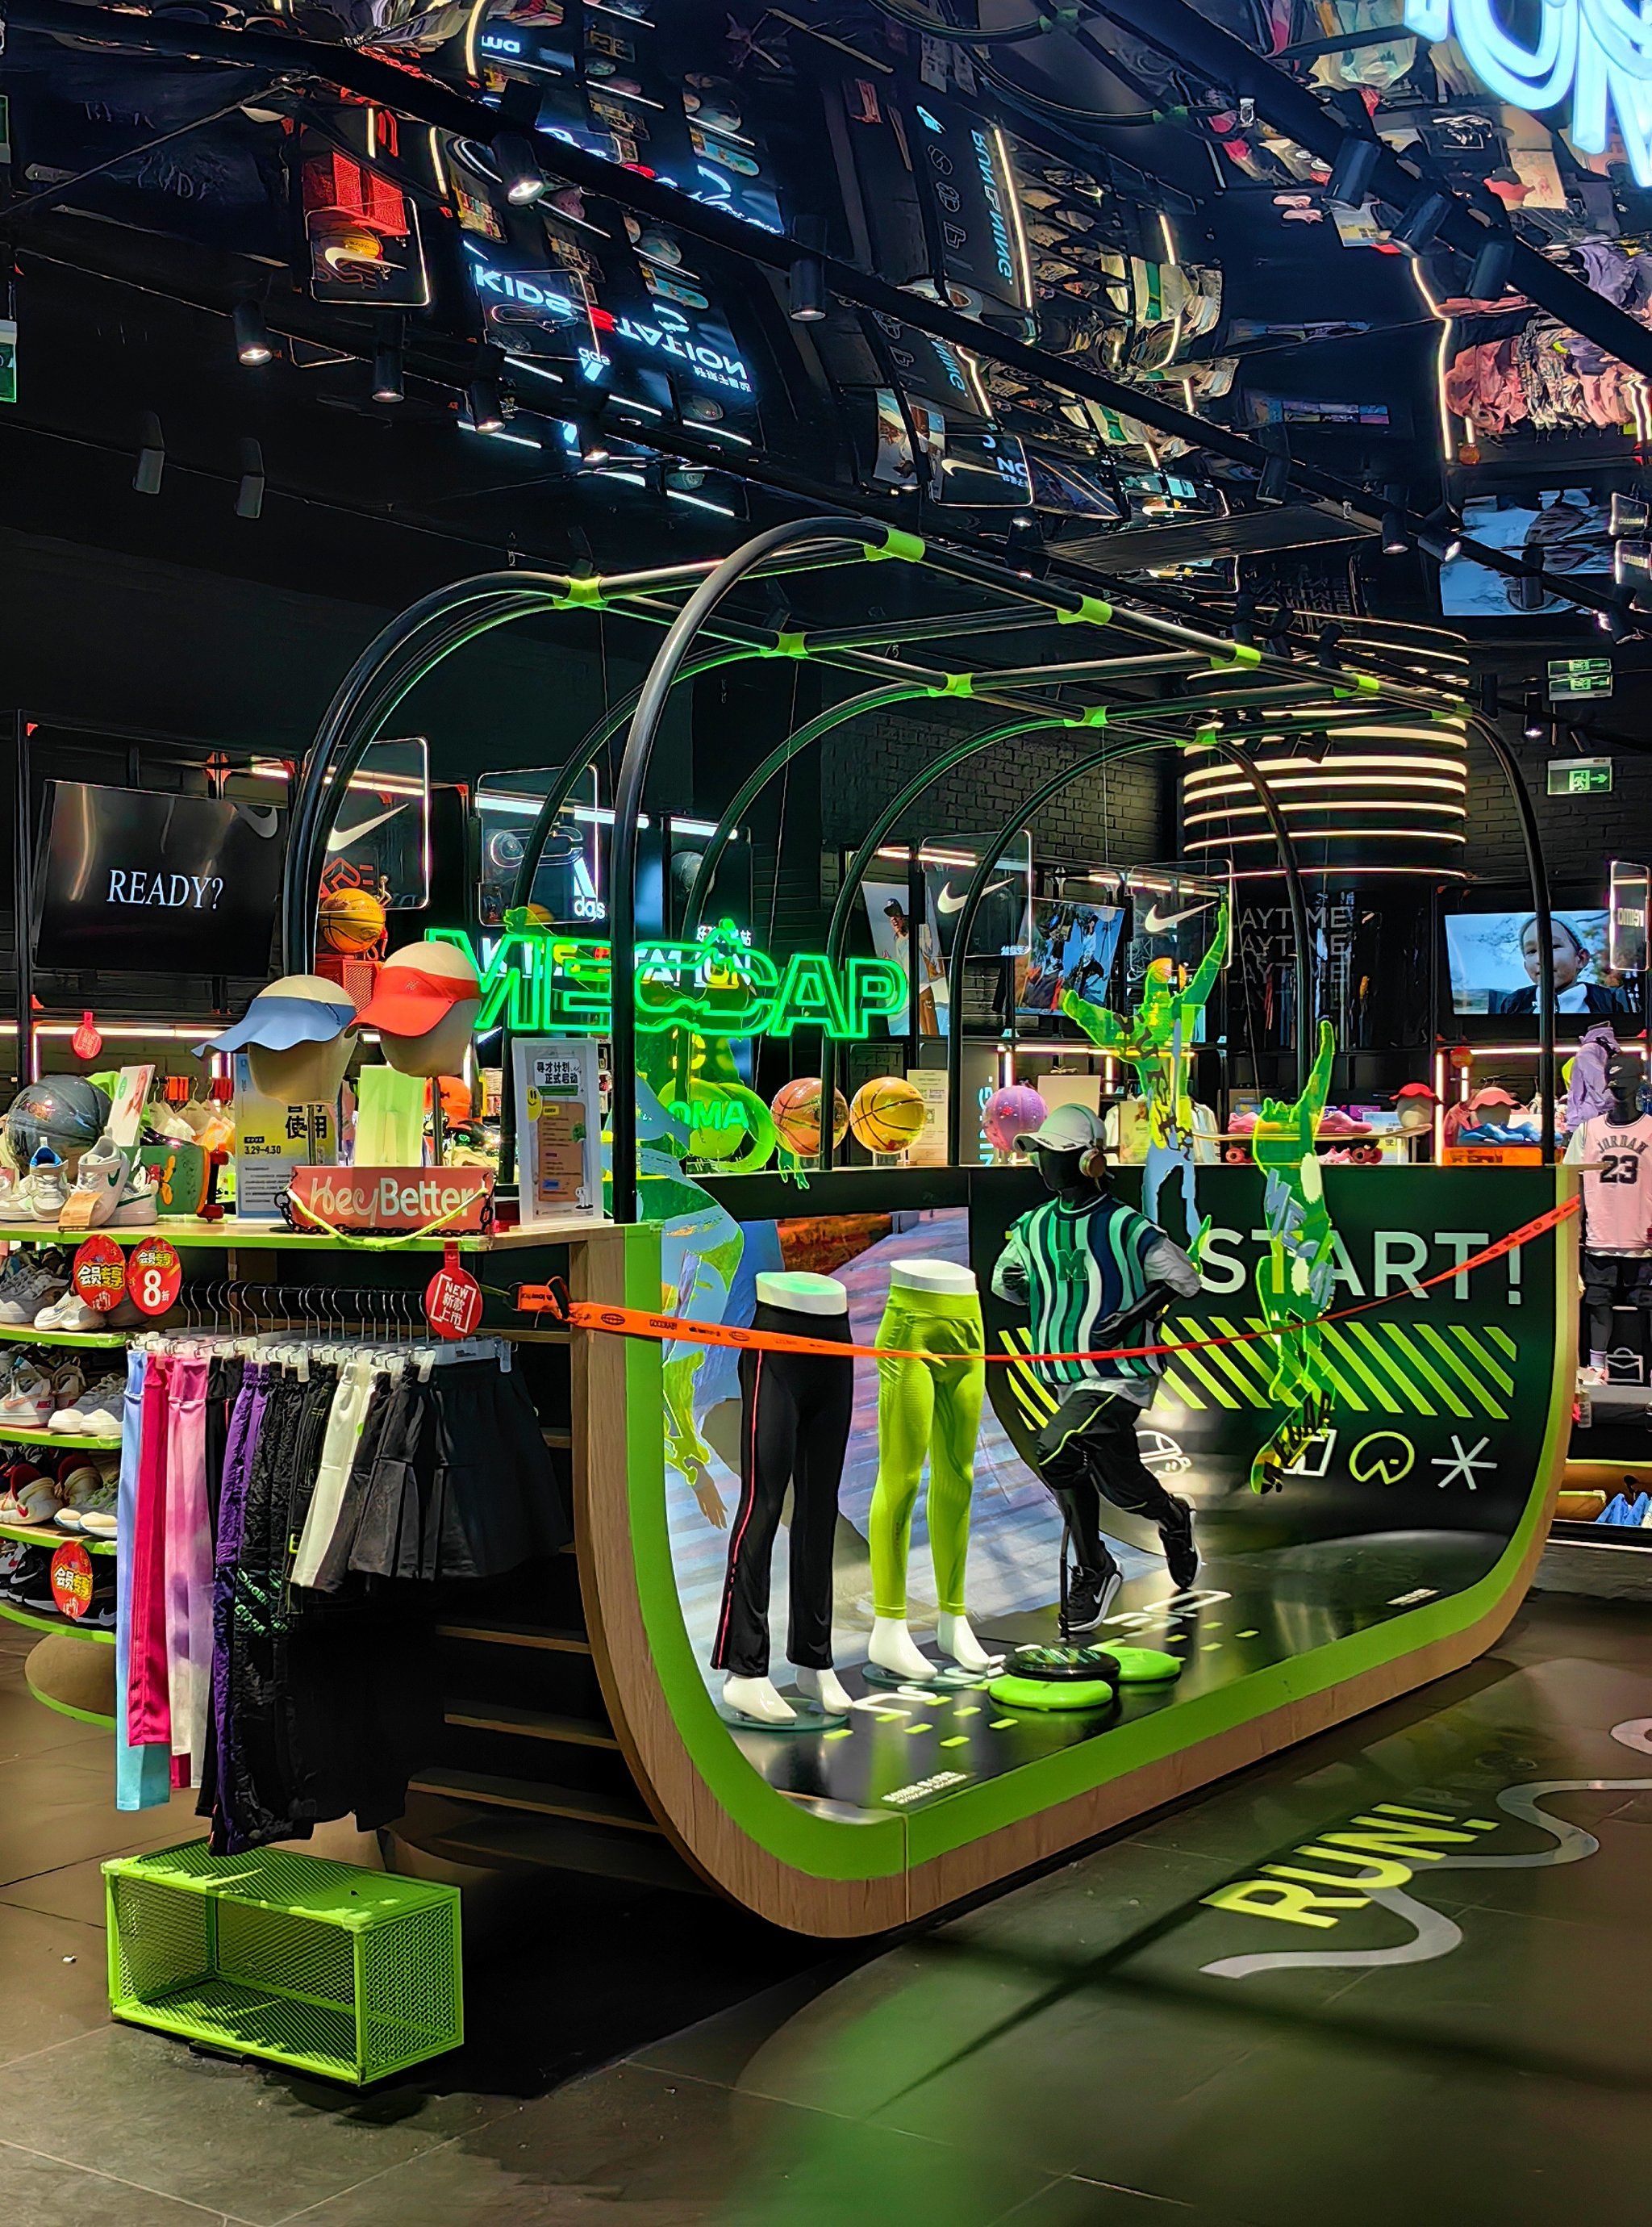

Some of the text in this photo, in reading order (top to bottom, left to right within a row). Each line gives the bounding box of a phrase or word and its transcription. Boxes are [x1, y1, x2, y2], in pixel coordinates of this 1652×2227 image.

[106, 869, 223, 909] READY?
[1597, 1134, 1648, 1155] JORDAN
[1600, 1155, 1638, 1184] 23
[1058, 1248, 1087, 1281] M
[1198, 1228, 1523, 1306] START!
[443, 1293, 465, 1312] 新款
[444, 1281, 468, 1299] NEW
[440, 1309, 462, 1327] 上市
[1199, 1803, 1501, 1929] RUN!
